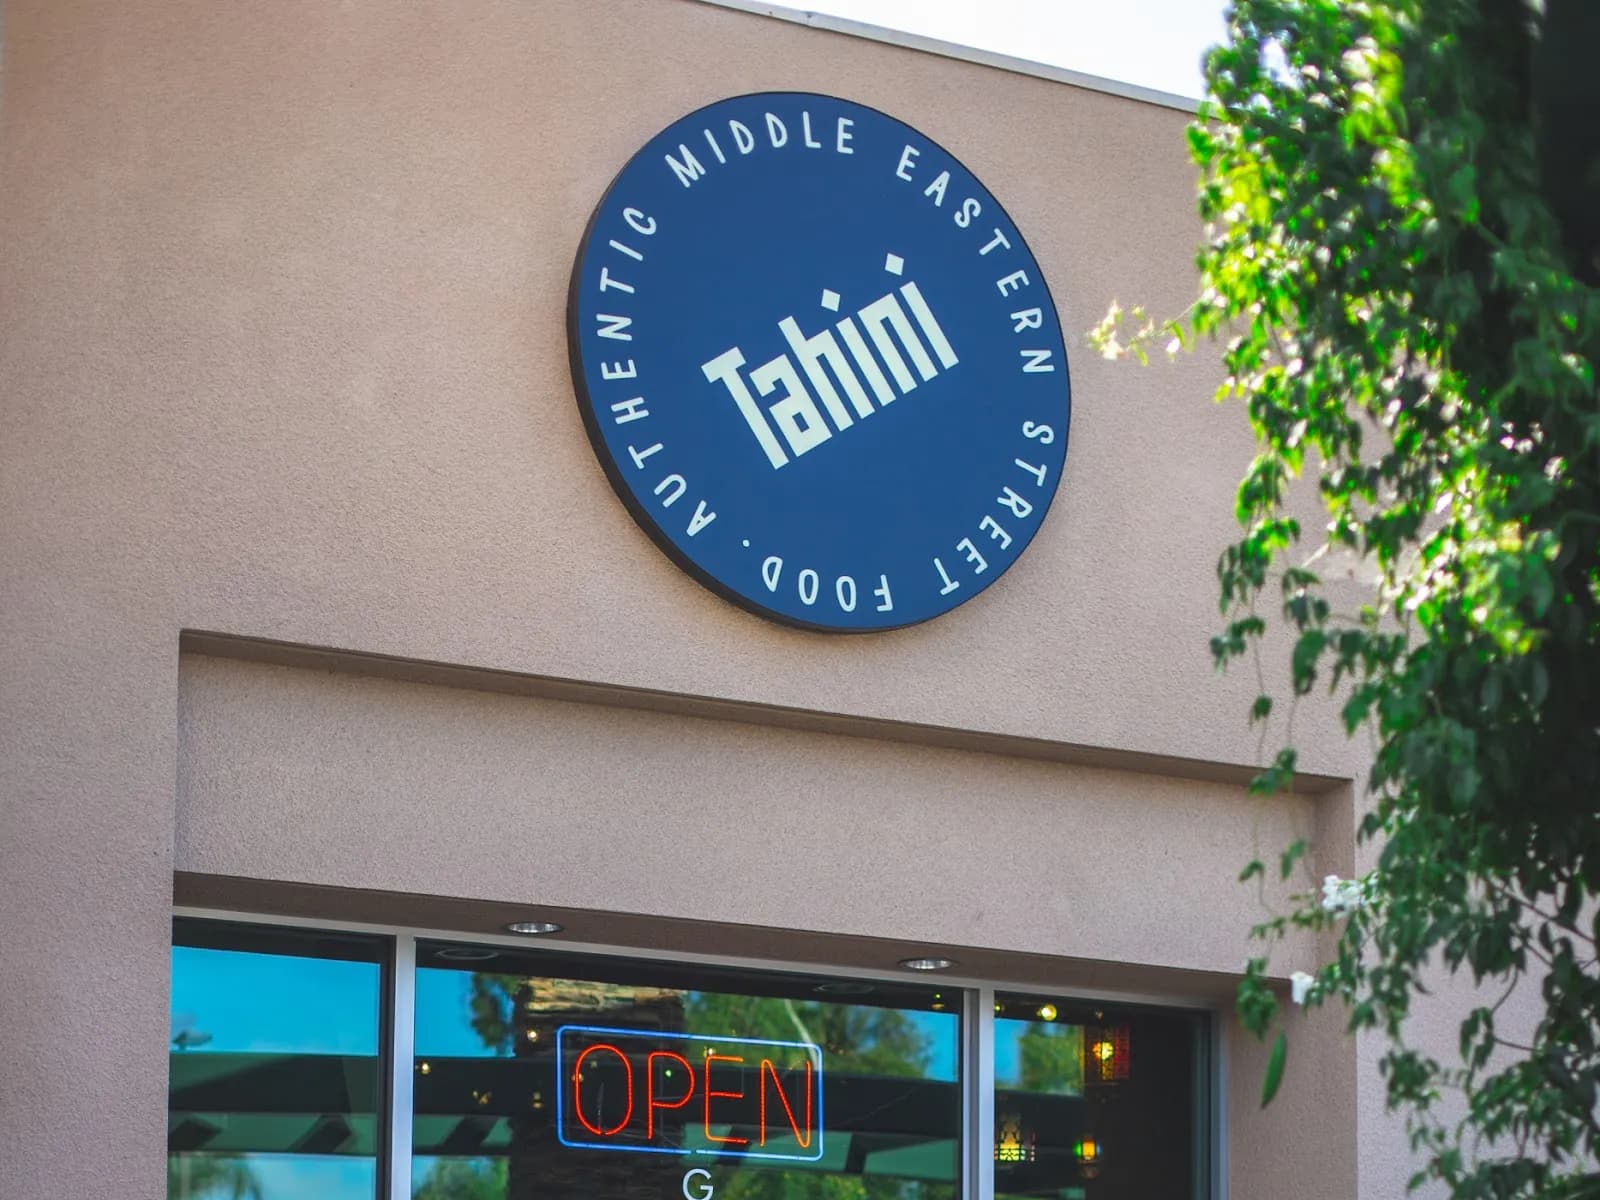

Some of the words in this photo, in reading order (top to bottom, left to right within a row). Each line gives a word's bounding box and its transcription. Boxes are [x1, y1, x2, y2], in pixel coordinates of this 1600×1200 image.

[664, 110, 854, 188] MIDDLE
[895, 145, 1056, 374] EASTERN
[596, 206, 716, 537] AUTHENTIC
[701, 252, 960, 470] Tahini
[934, 420, 1056, 597] STREET
[574, 1043, 813, 1148] OPEN
